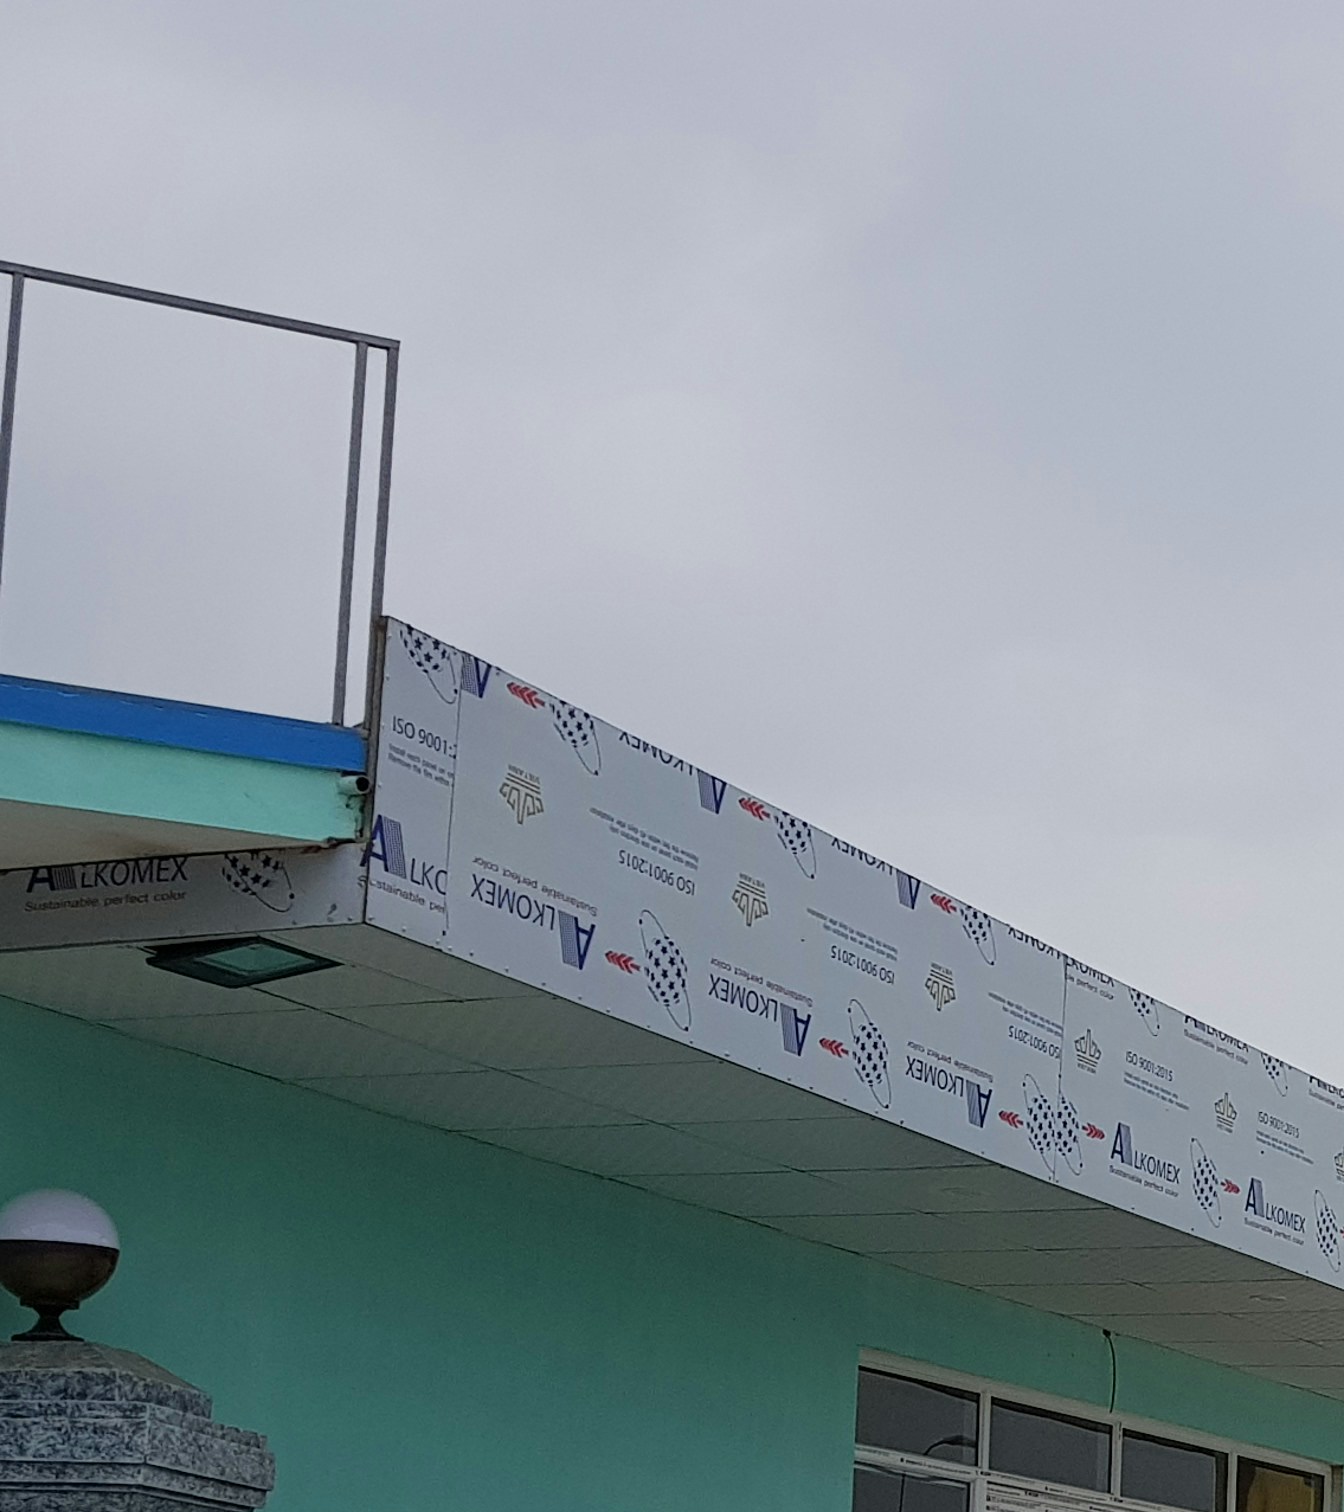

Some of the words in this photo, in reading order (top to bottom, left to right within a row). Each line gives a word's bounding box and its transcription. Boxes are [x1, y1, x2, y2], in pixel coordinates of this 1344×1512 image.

[392, 715, 417, 743] ISO
[618, 850, 675, 890] 9001:2015
[677, 875, 696, 896] ISO
[470, 873, 597, 971] ALKOMEX
[708, 973, 812, 1057] ALKOMEX
[905, 1054, 993, 1129] ALKOMEX
[1110, 1121, 1181, 1186] ALKOMEX
